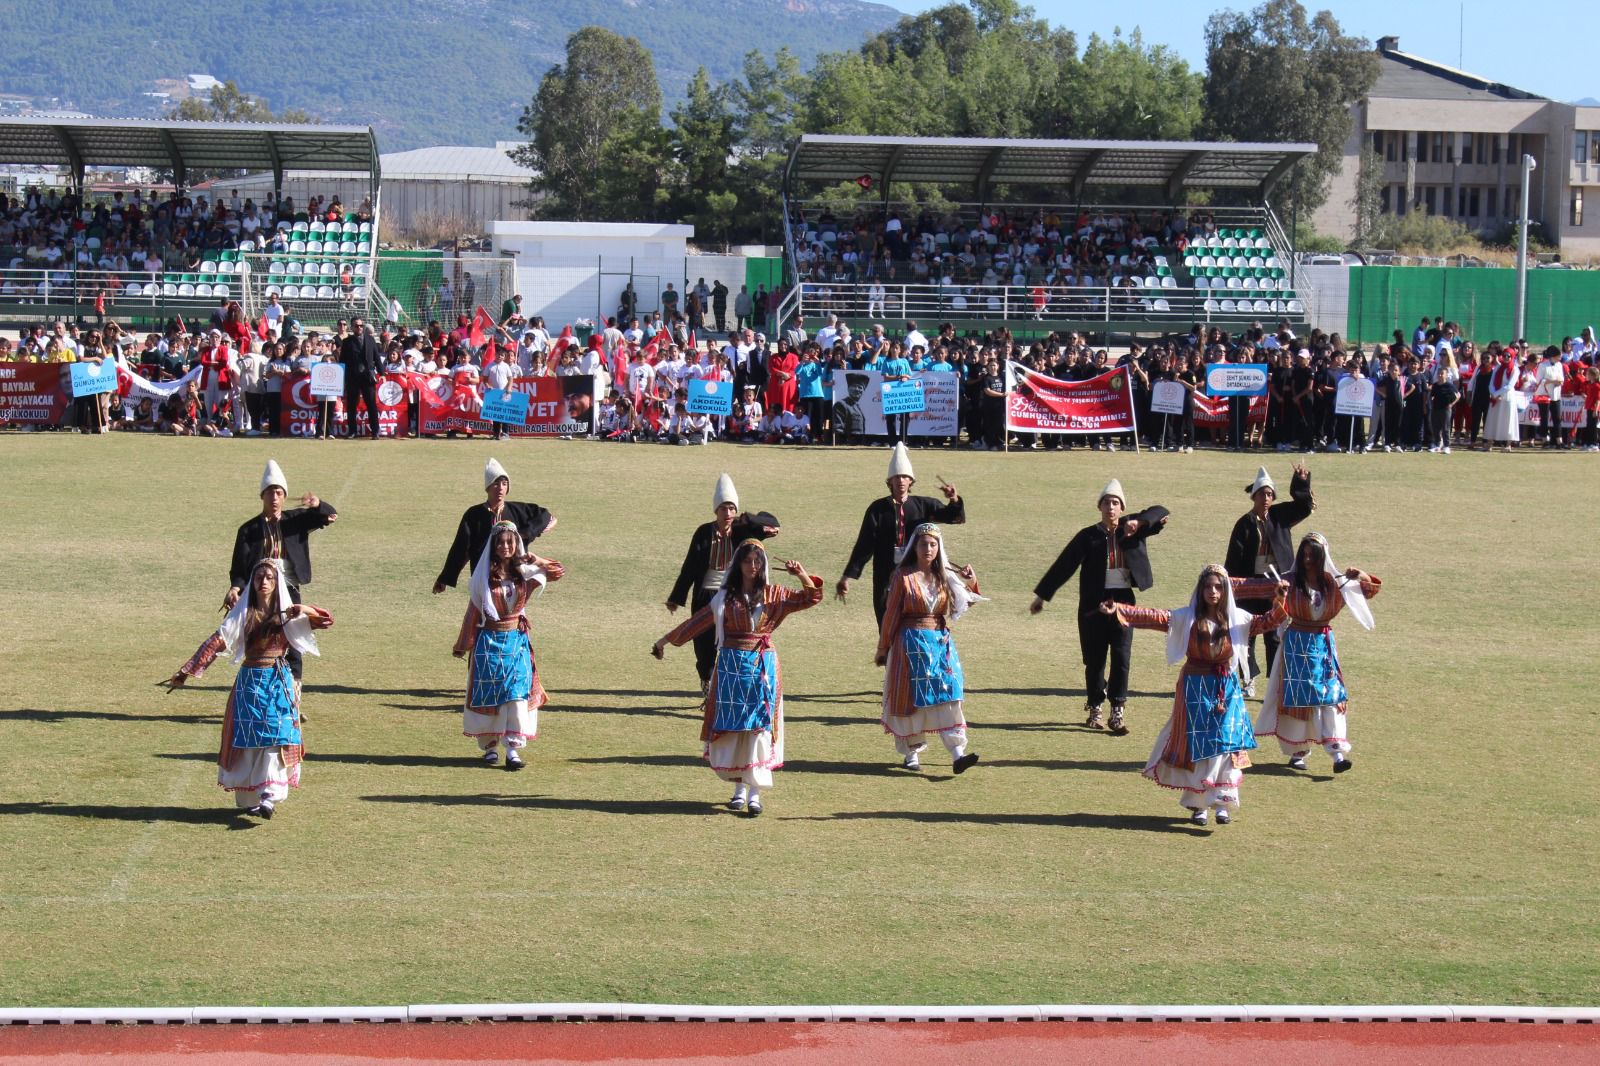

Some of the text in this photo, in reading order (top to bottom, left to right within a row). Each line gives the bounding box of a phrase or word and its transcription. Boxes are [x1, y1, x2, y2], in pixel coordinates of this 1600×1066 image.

[2, 381, 35, 392] BAYRAK
[8, 394, 54, 408] YAŞAYACAK
[692, 398, 727, 406] AKDENİZ
[11, 406, 49, 419] İLKOKULU
[690, 404, 728, 412] İLKOKULU
[884, 404, 924, 412] ORTAOKULU
[1011, 411, 1068, 420] CUMHURİYET
[464, 420, 494, 431] TEMMU
[548, 421, 589, 433] İLKOKULU
[1037, 419, 1067, 427] KUTLU
